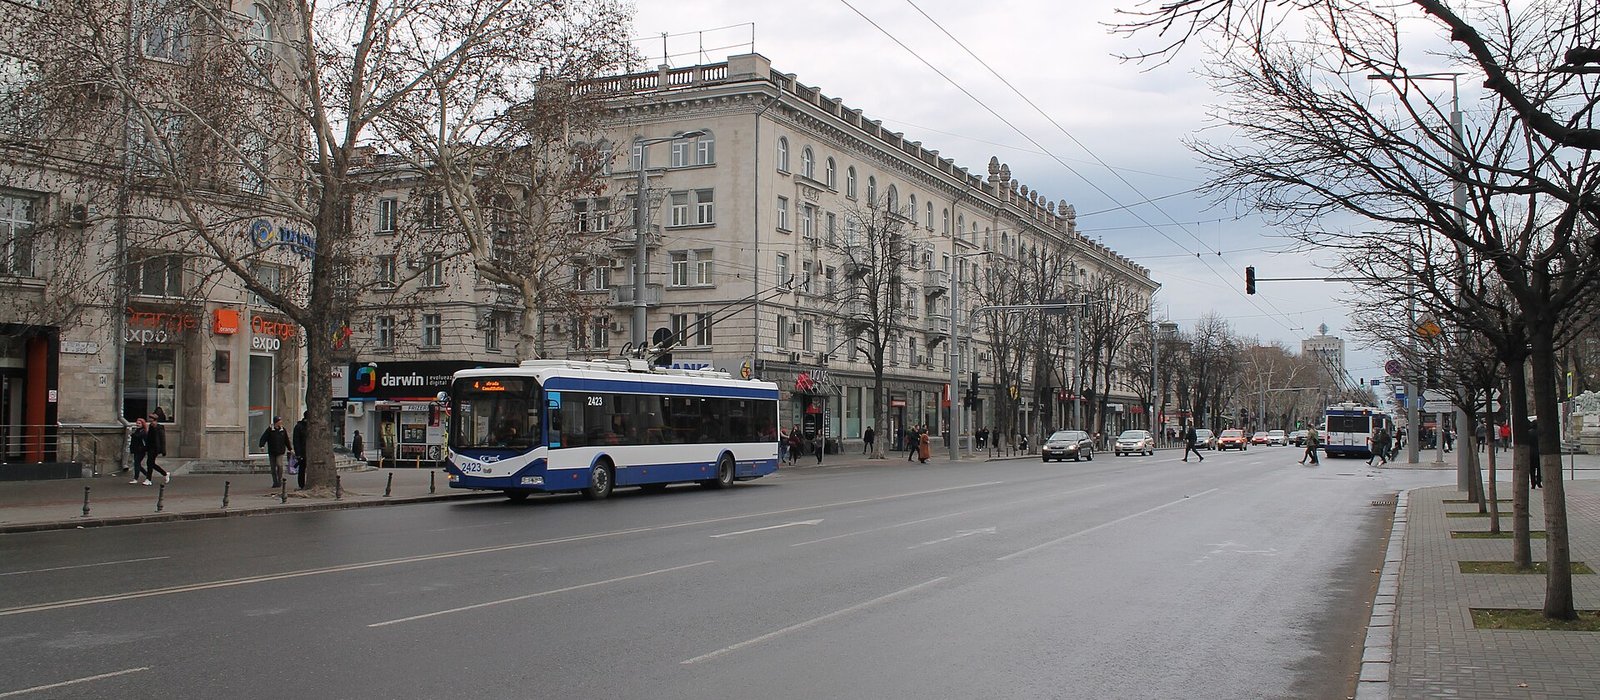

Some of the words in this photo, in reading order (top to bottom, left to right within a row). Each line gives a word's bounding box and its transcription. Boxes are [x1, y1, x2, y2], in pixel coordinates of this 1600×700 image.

[252, 315, 295, 341] Orange
[252, 336, 280, 353] expo
[381, 372, 424, 387] darwin
[474, 381, 479, 389] 4
[587, 396, 603, 406] 2423
[461, 462, 481, 472] 2423
